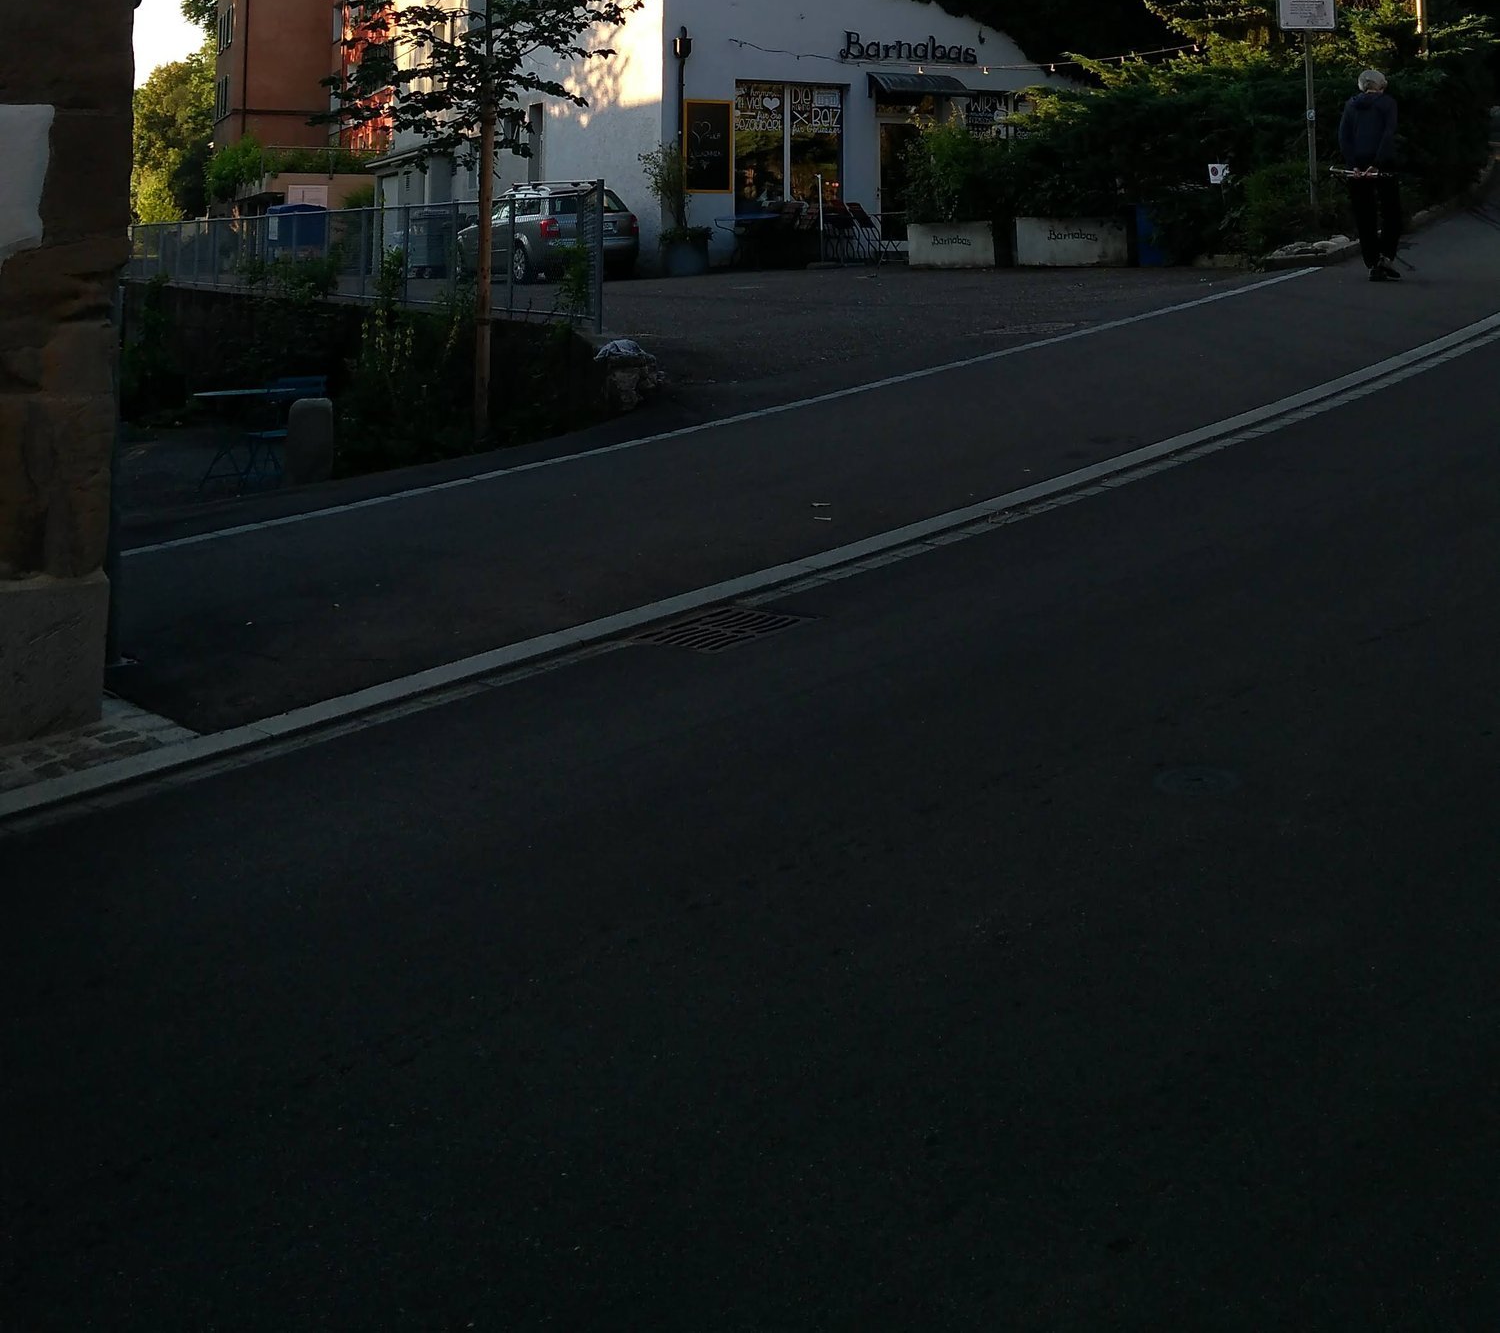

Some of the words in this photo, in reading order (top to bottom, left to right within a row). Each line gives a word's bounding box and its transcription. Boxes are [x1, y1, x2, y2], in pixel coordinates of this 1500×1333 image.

[839, 30, 978, 64] Barnabas
[931, 235, 972, 246] Barnabas
[1047, 229, 1098, 242] Barnabas
